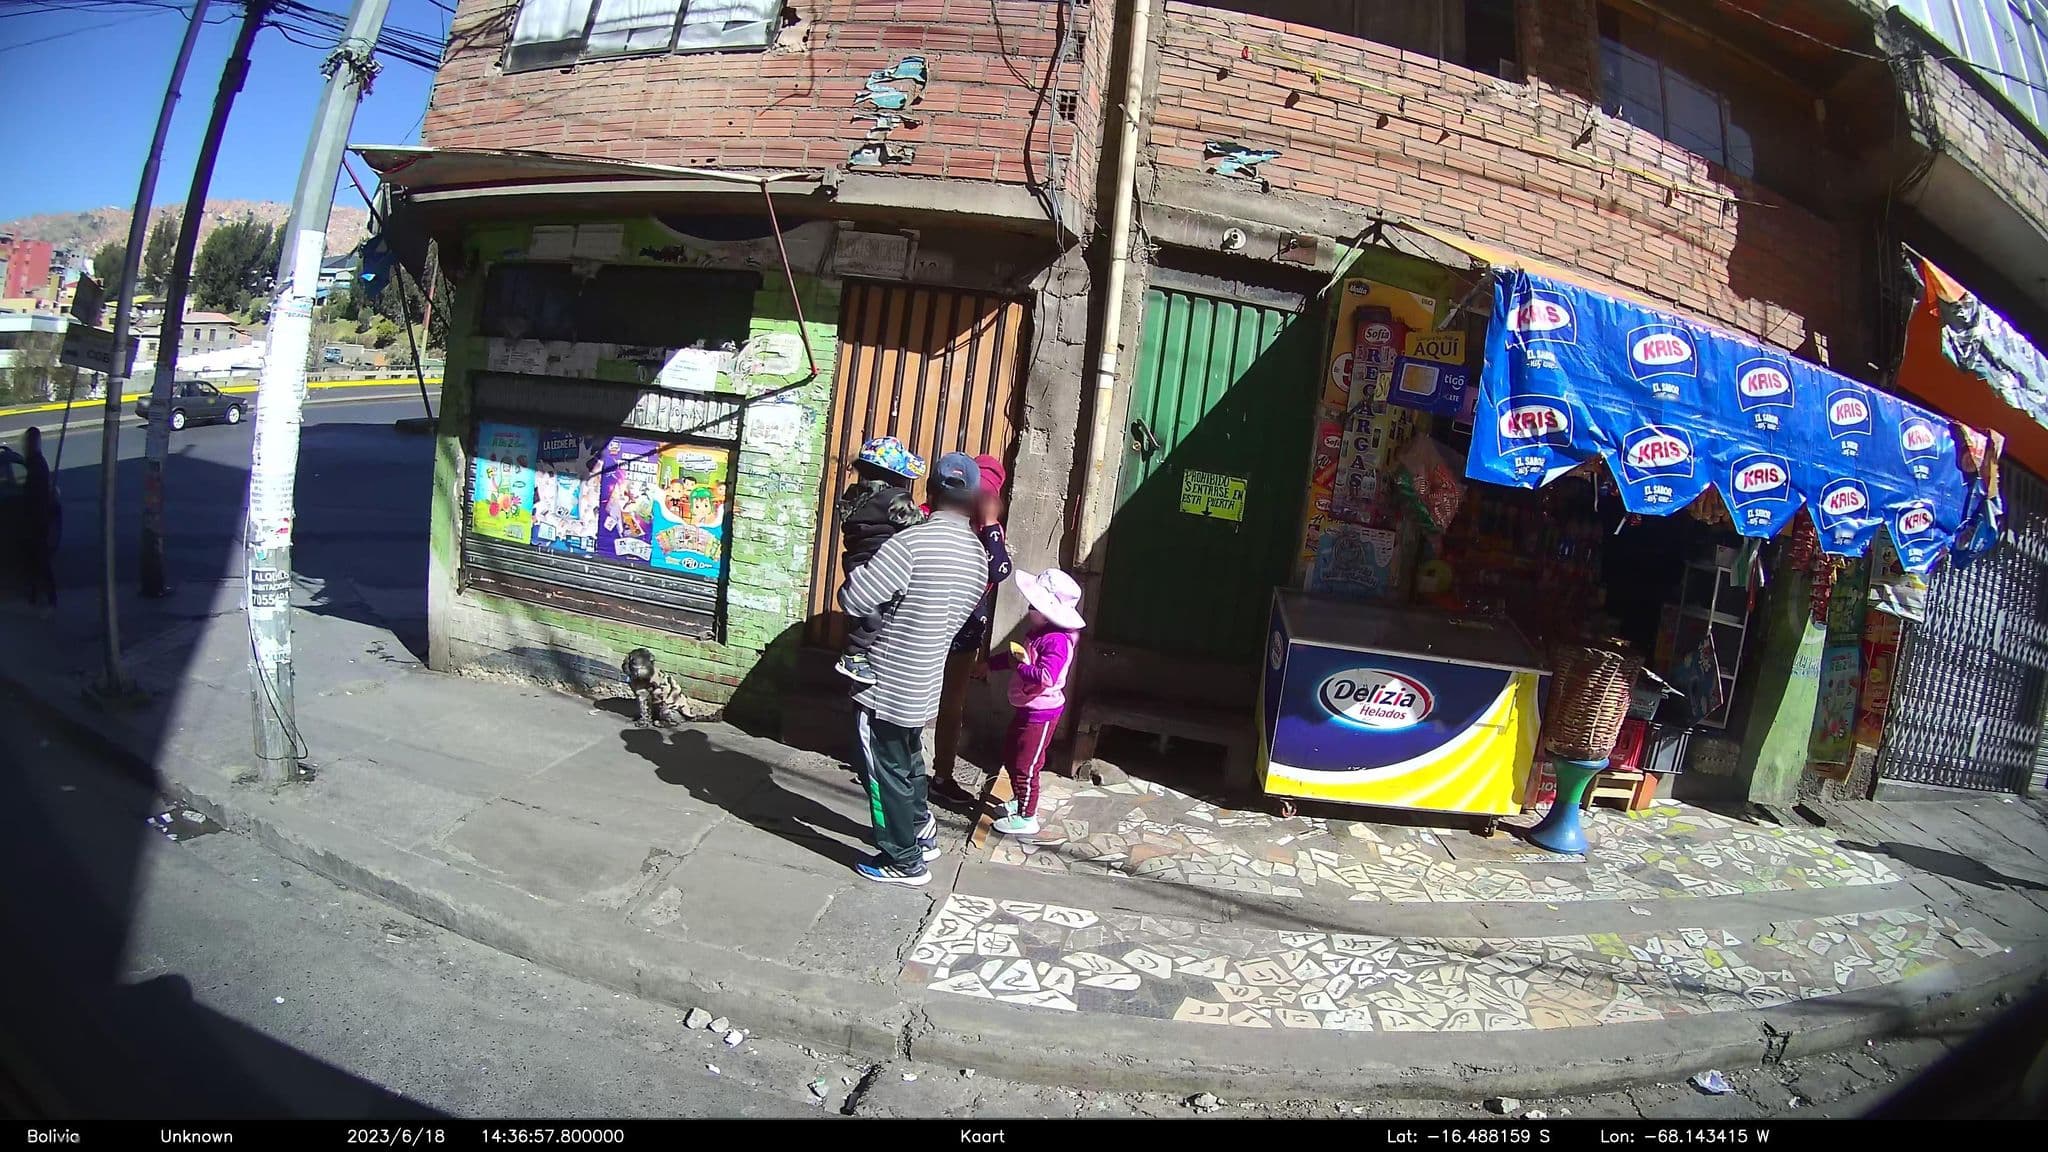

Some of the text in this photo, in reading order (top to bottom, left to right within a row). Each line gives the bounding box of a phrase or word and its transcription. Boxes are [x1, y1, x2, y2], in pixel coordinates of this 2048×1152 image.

[1414, 338, 1459, 360] AQUÍ
[1643, 339, 1684, 361] KRIS
[1445, 374, 1465, 387] tigo
[1747, 373, 1782, 393] KRIS
[1508, 411, 1559, 434] KRIS
[1836, 403, 1862, 422] KRIS
[1638, 441, 1681, 464] KRIS
[1743, 468, 1779, 489] KRIS
[1182, 494, 1202, 505] ESTA
[1830, 492, 1859, 510] KRIS
[1904, 512, 1929, 531] KRIS
[1333, 680, 1416, 708] Delizia
[1360, 705, 1407, 720] Helados
